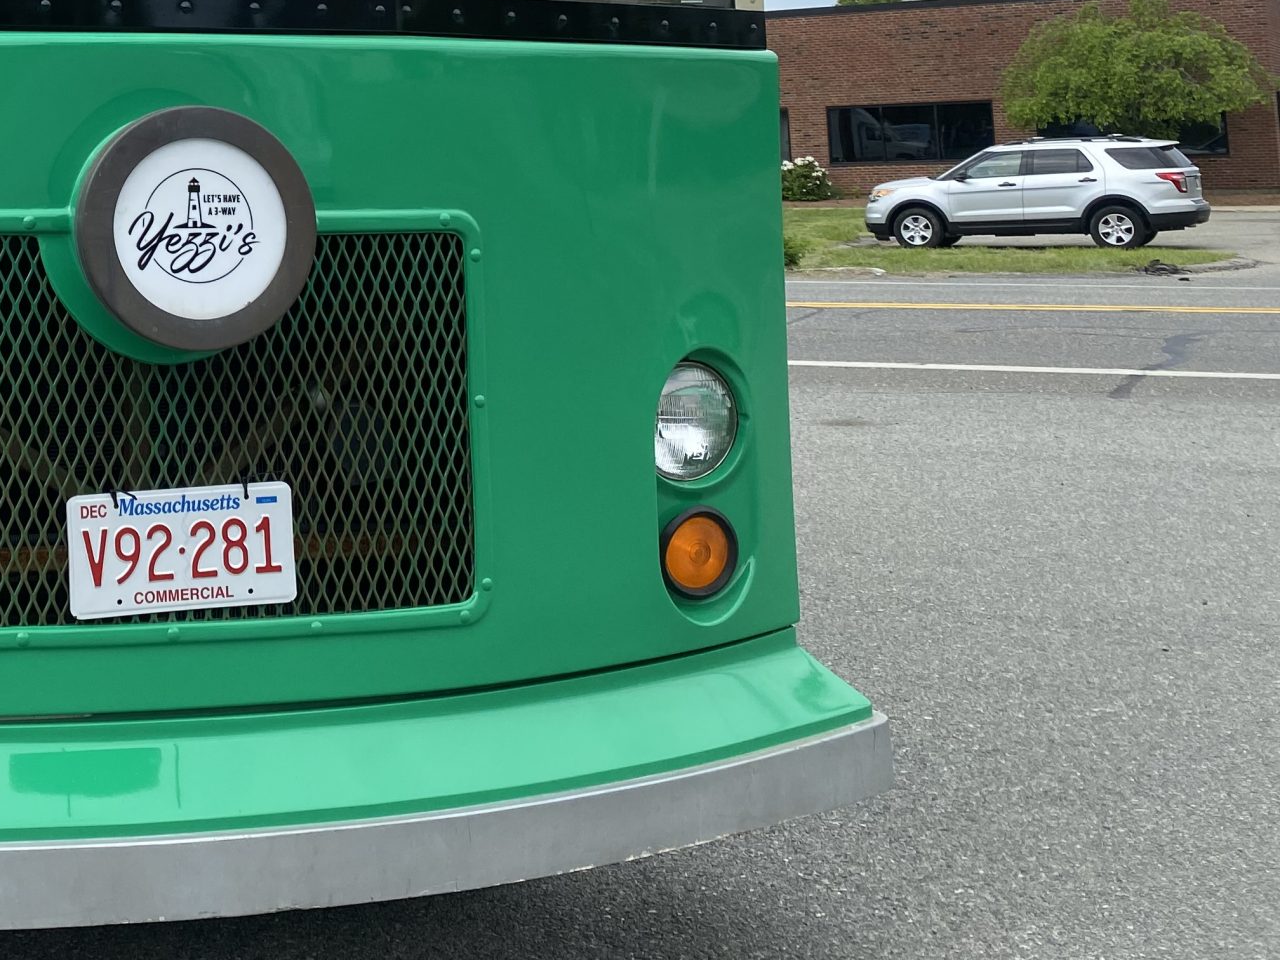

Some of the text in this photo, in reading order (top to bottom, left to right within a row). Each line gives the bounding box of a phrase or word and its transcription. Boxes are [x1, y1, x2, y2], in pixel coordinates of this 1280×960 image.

[203, 194, 241, 203] LET'S HAVE
[208, 206, 236, 216] A 3-WAY
[128, 210, 261, 274] Yezzi's
[80, 504, 108, 520] DEC
[119, 494, 241, 517] Massachusetts
[133, 585, 235, 605] COMMERCIAL
